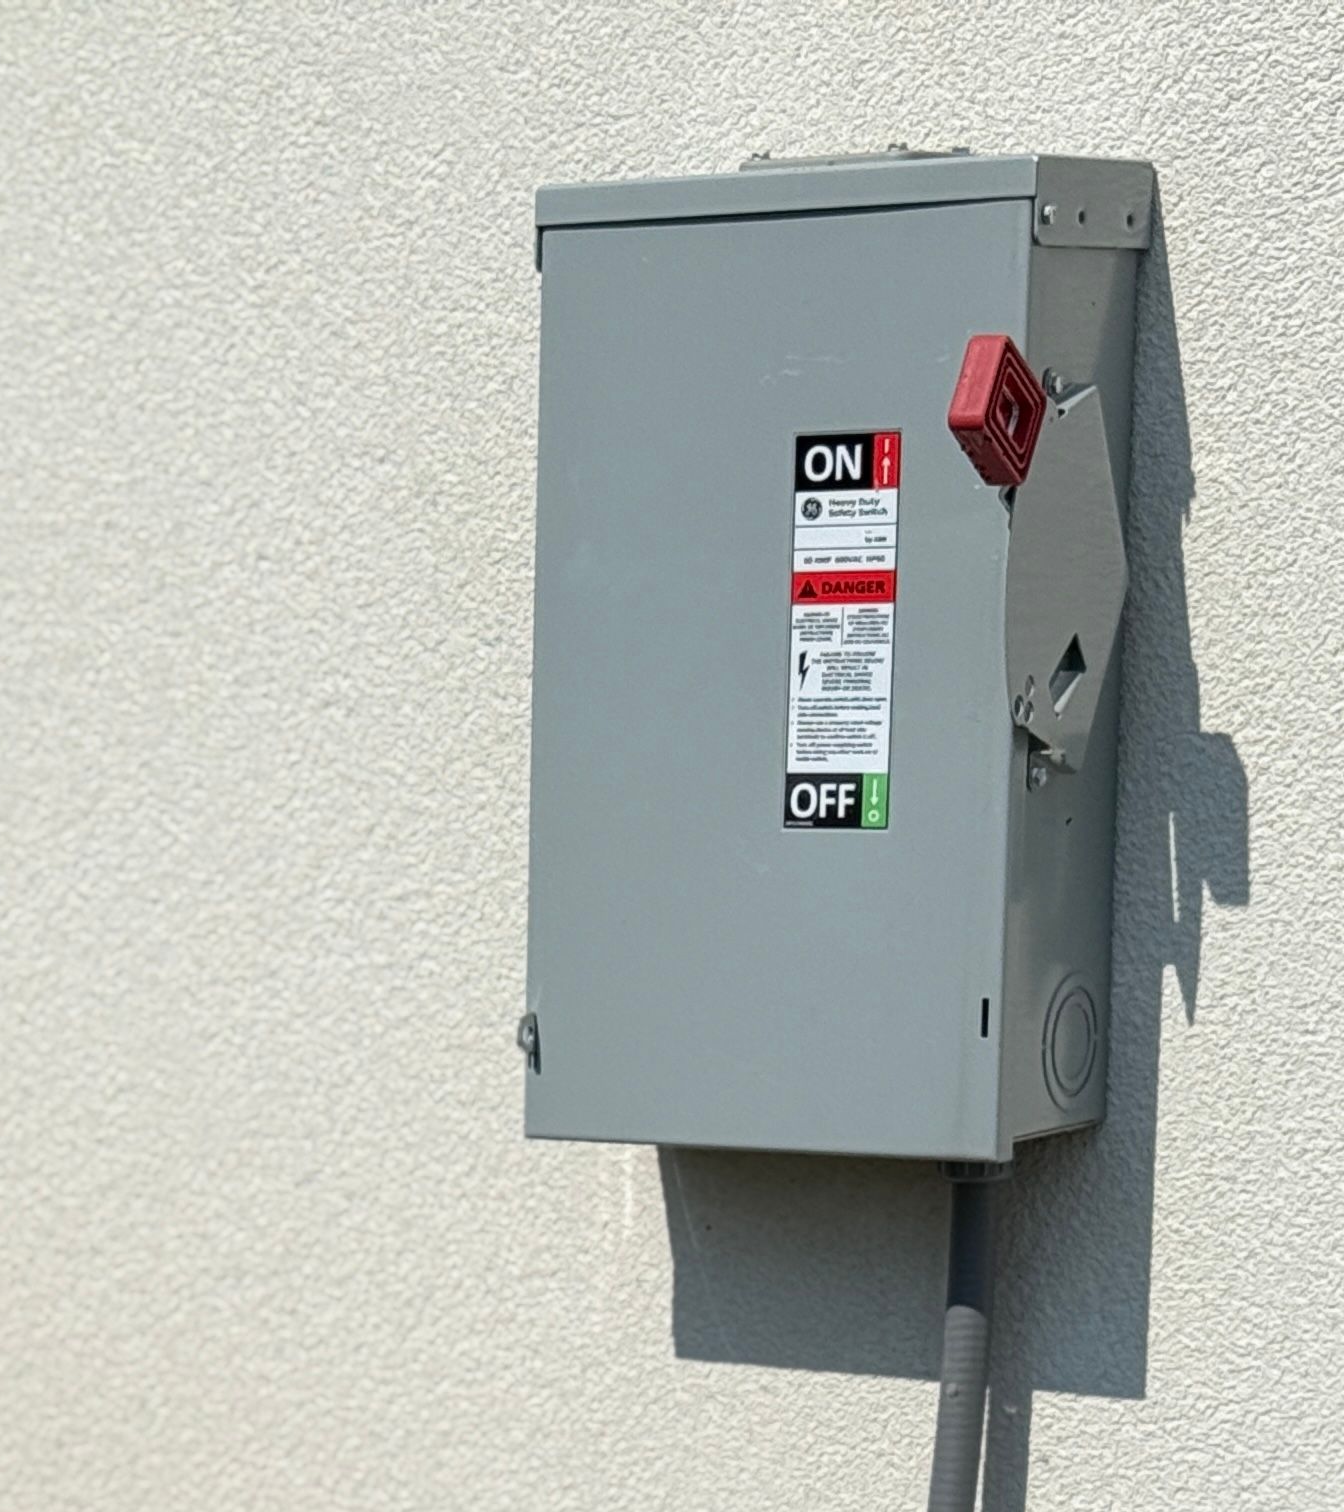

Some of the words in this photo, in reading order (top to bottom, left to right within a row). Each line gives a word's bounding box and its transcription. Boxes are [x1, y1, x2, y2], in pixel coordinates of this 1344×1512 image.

[804, 443, 863, 482] ON
[858, 497, 880, 506] Duty
[821, 580, 886, 594] DANGER
[790, 782, 857, 819] OFF
